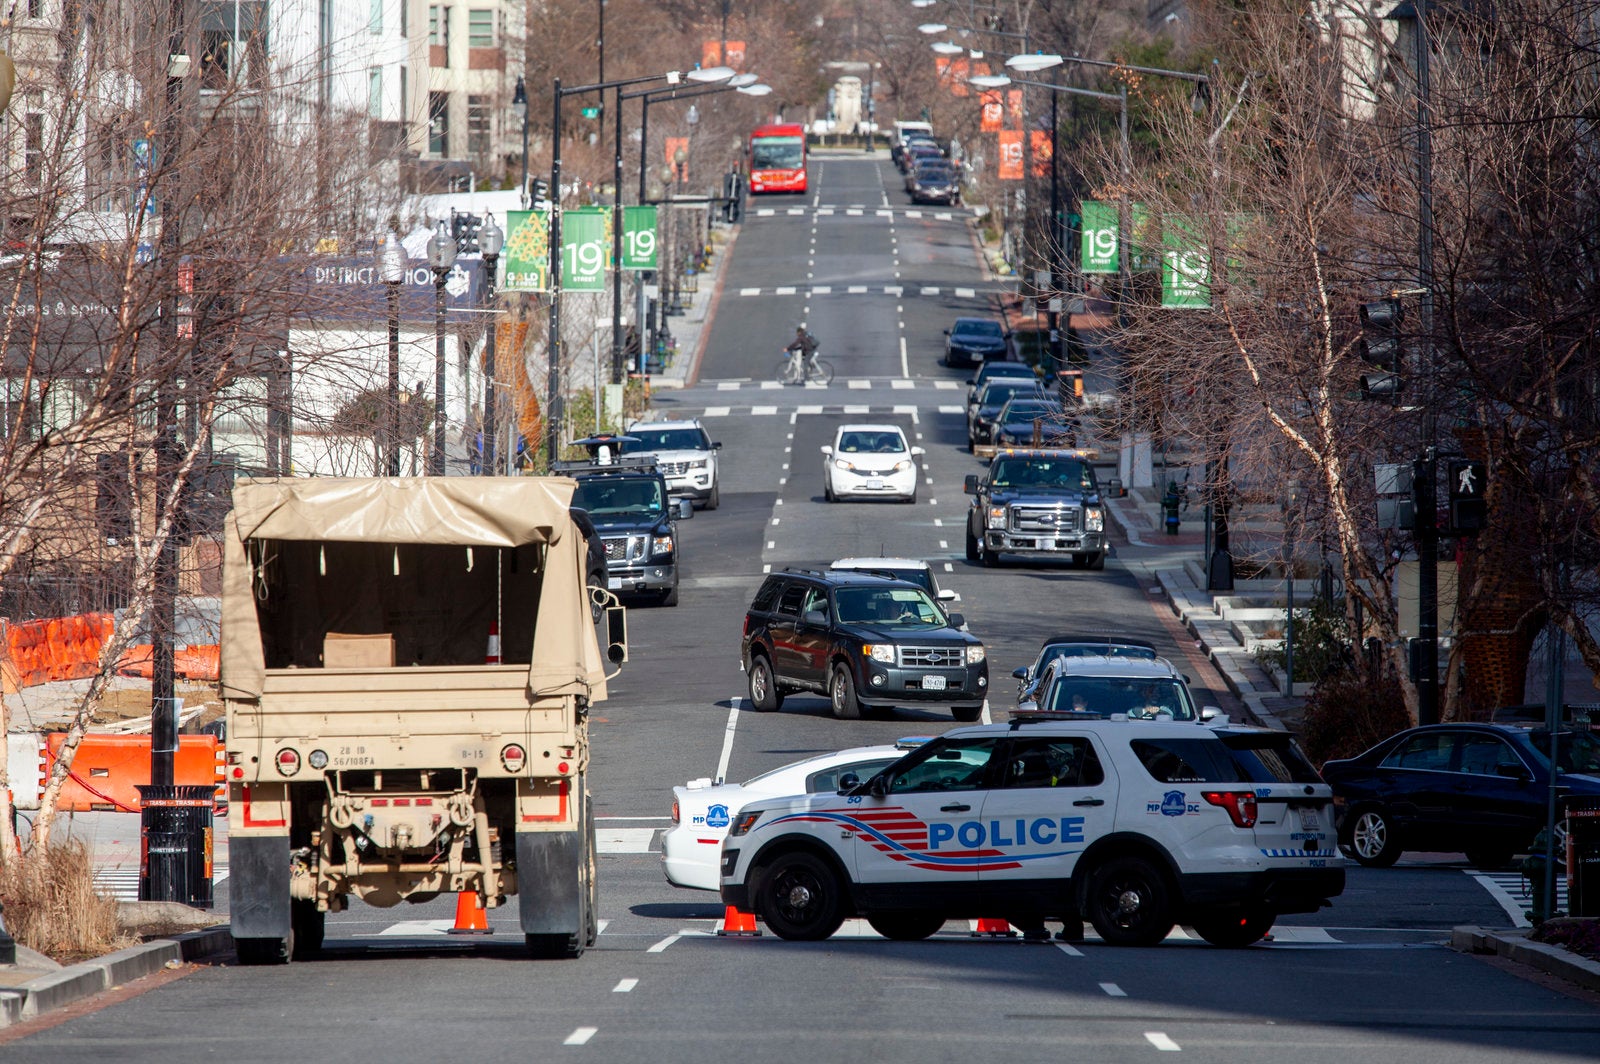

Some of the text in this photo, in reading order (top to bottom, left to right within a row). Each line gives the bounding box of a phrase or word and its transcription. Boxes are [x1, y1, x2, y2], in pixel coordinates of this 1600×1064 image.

[315, 267, 374, 284] DISTRICT
[3, 304, 49, 317] cgas
[340, 746, 350, 754] 28
[1147, 804, 1200, 812] MP DC
[929, 817, 1085, 849] POLICE
